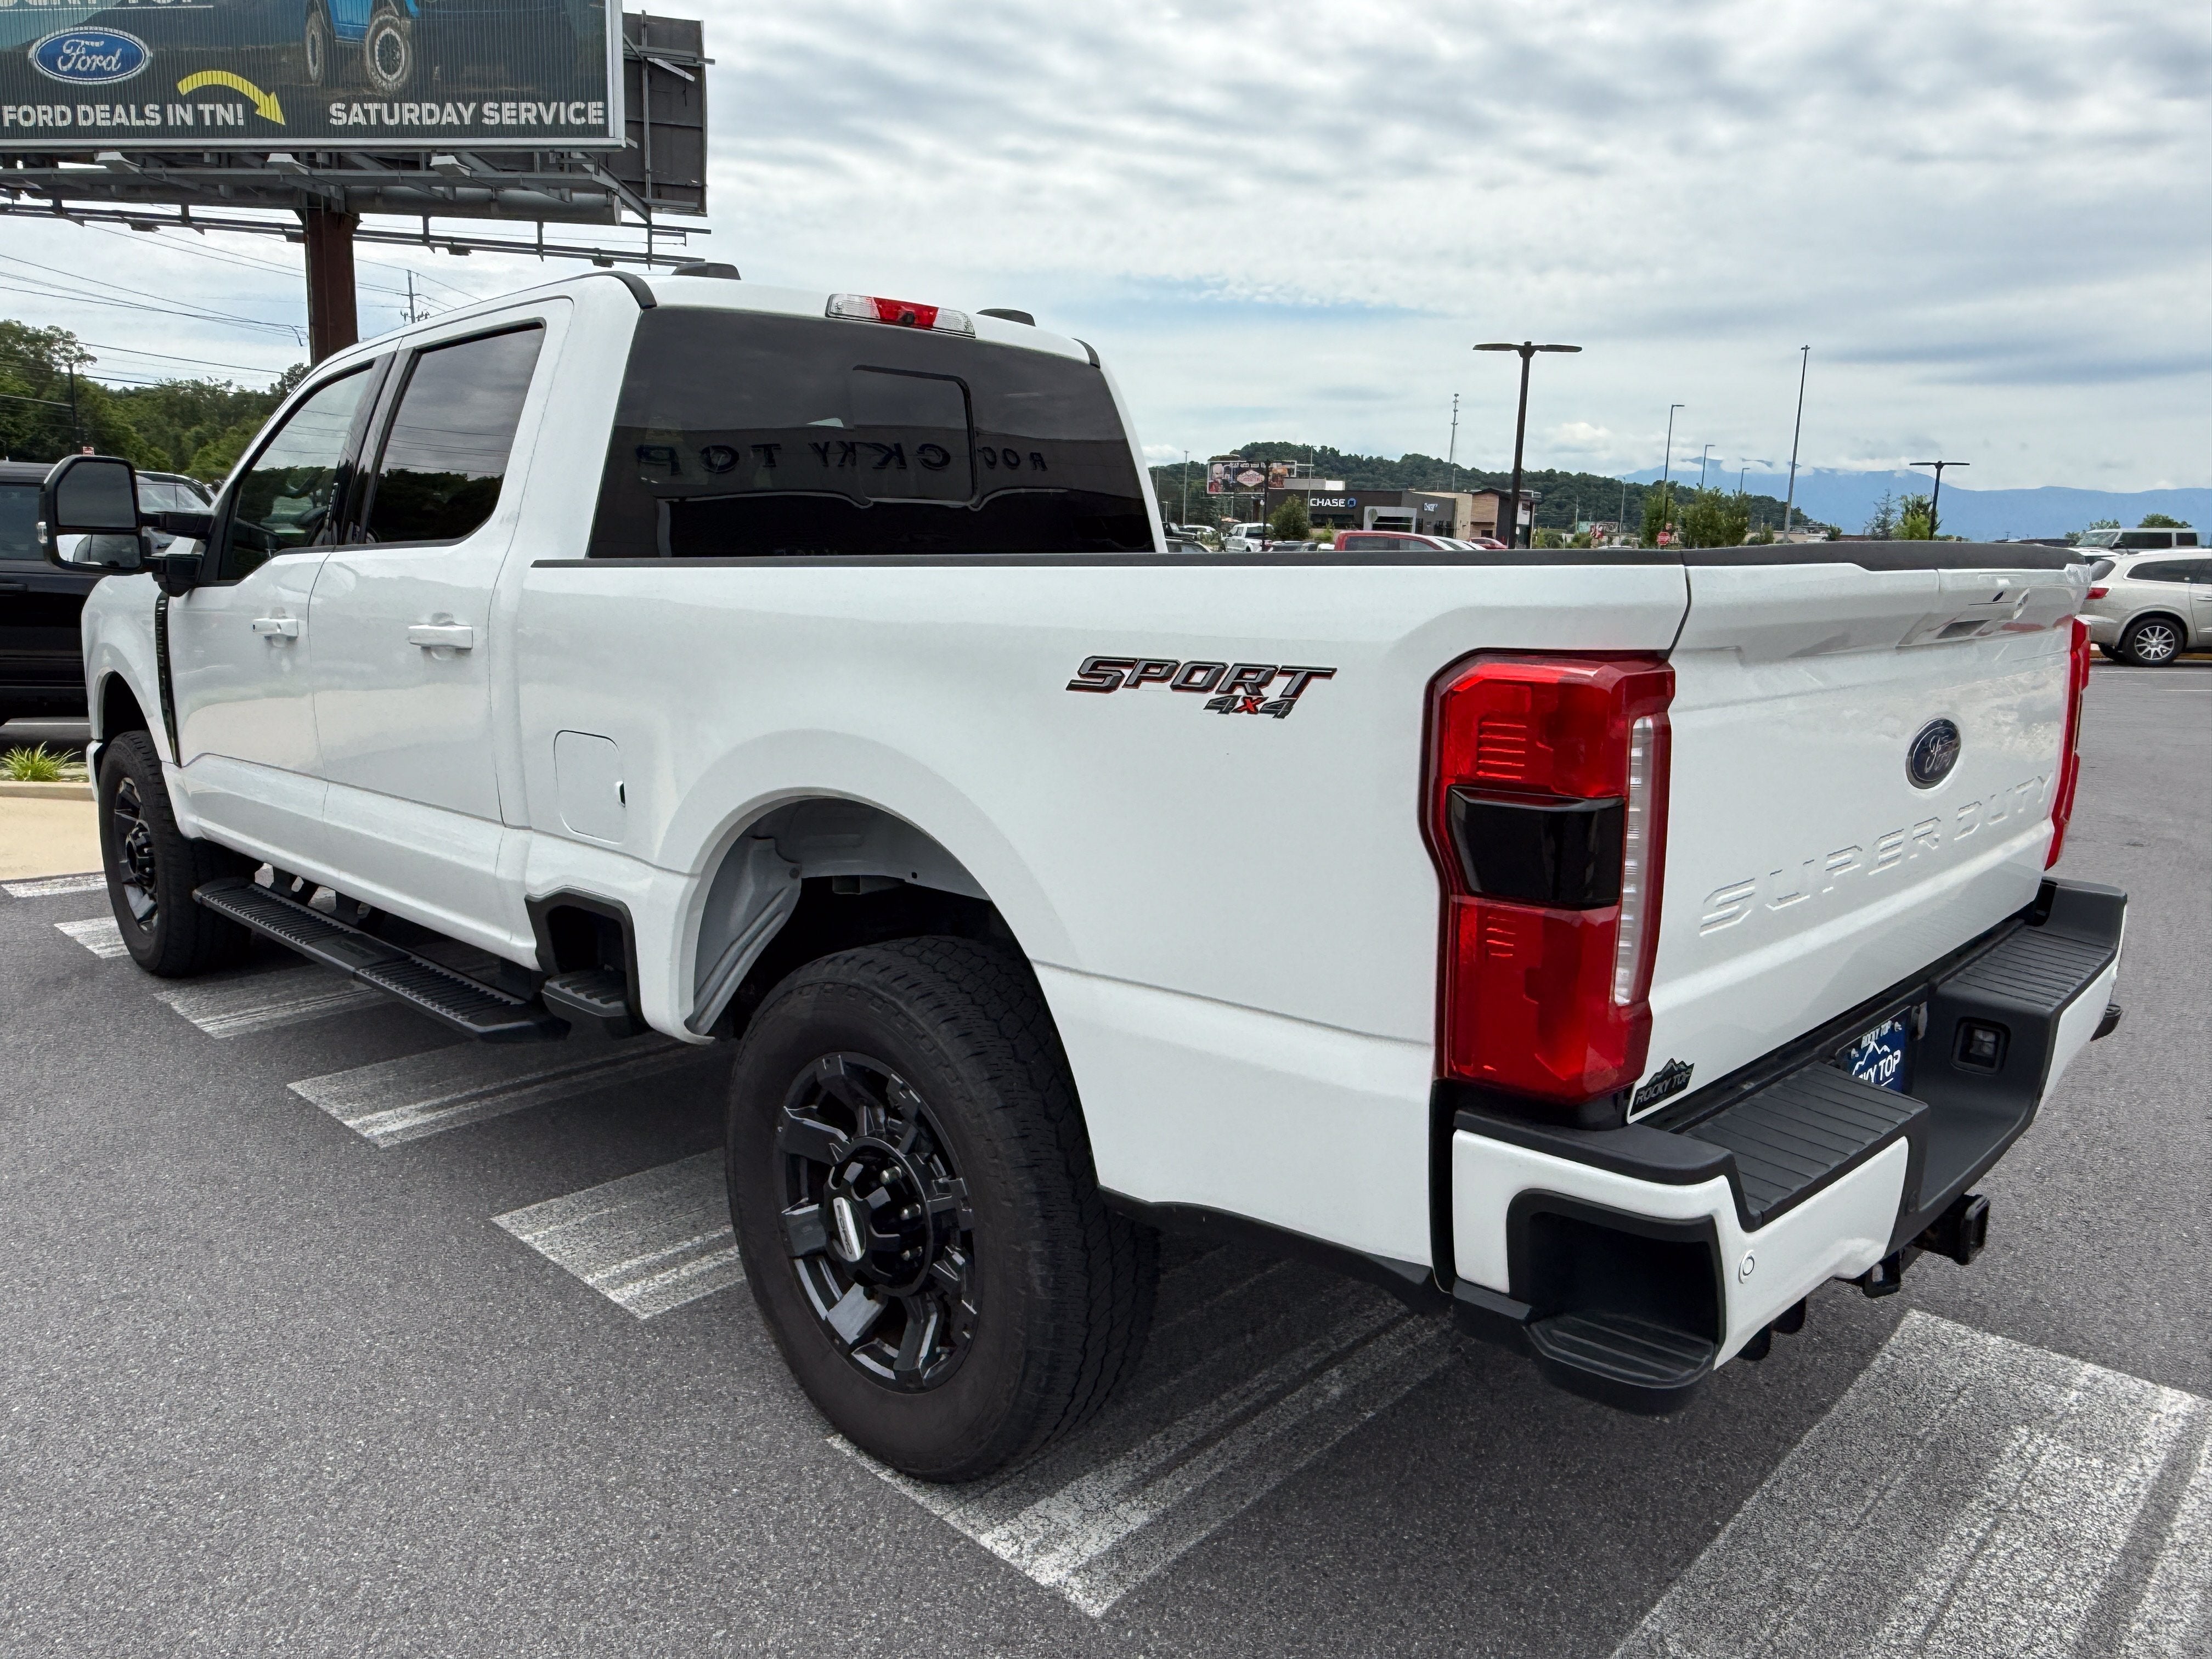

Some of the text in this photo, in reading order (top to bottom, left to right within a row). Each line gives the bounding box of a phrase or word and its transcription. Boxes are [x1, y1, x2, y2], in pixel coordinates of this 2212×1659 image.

[57, 39, 121, 72] Ford
[2, 103, 244, 127] FORD DEALS IN TN!
[329, 101, 605, 125] SATURDAY SERVICE
[1310, 498, 1345, 507] CHASE
[1066, 656, 1338, 699] SPORT
[1700, 770, 2053, 936] SUPER DUTY
[1878, 1049, 1901, 1081] TOP
[1635, 1077, 1672, 1105] ROCKY
